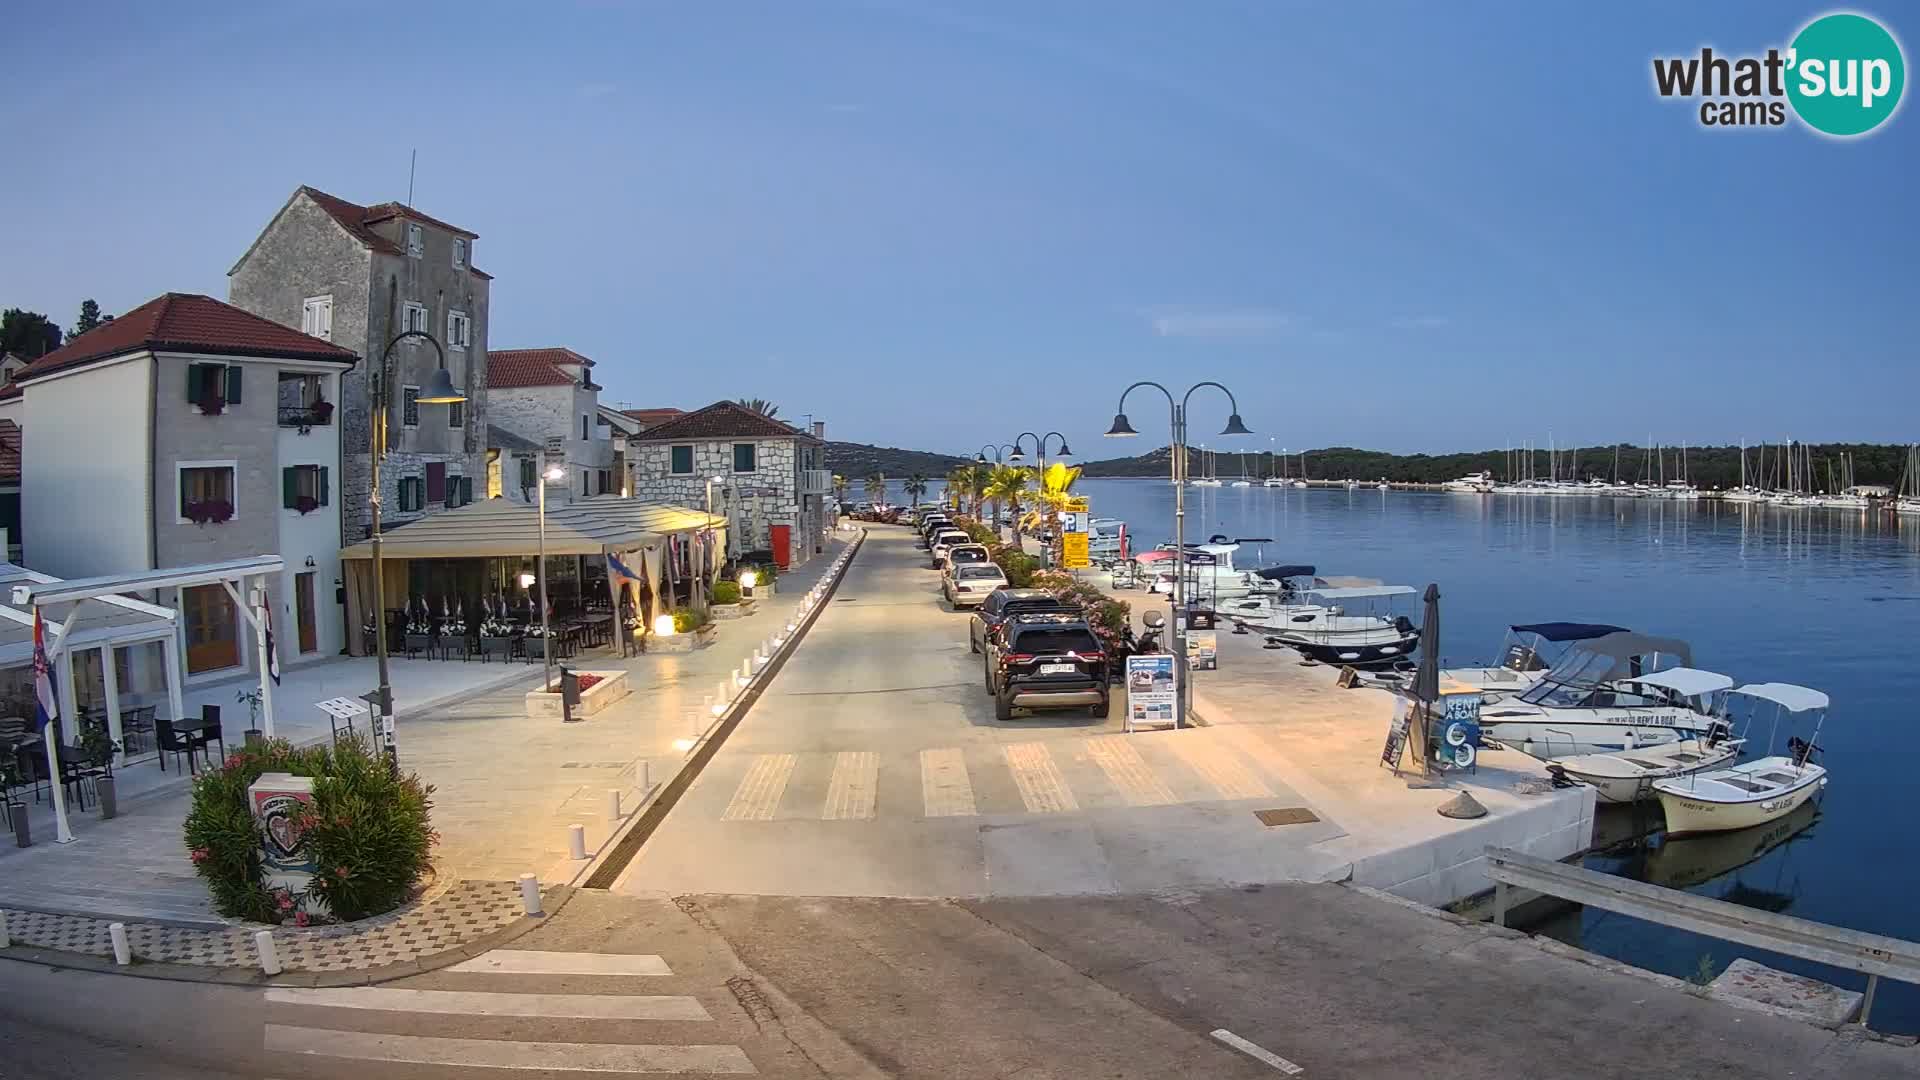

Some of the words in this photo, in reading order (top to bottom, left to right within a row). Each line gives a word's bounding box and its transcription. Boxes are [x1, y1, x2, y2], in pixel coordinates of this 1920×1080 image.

[1447, 698, 1480, 711] RENT
[1446, 711, 1453, 720] A
[1454, 710, 1477, 720] BOAT
[1637, 716, 1654, 725] RENT
